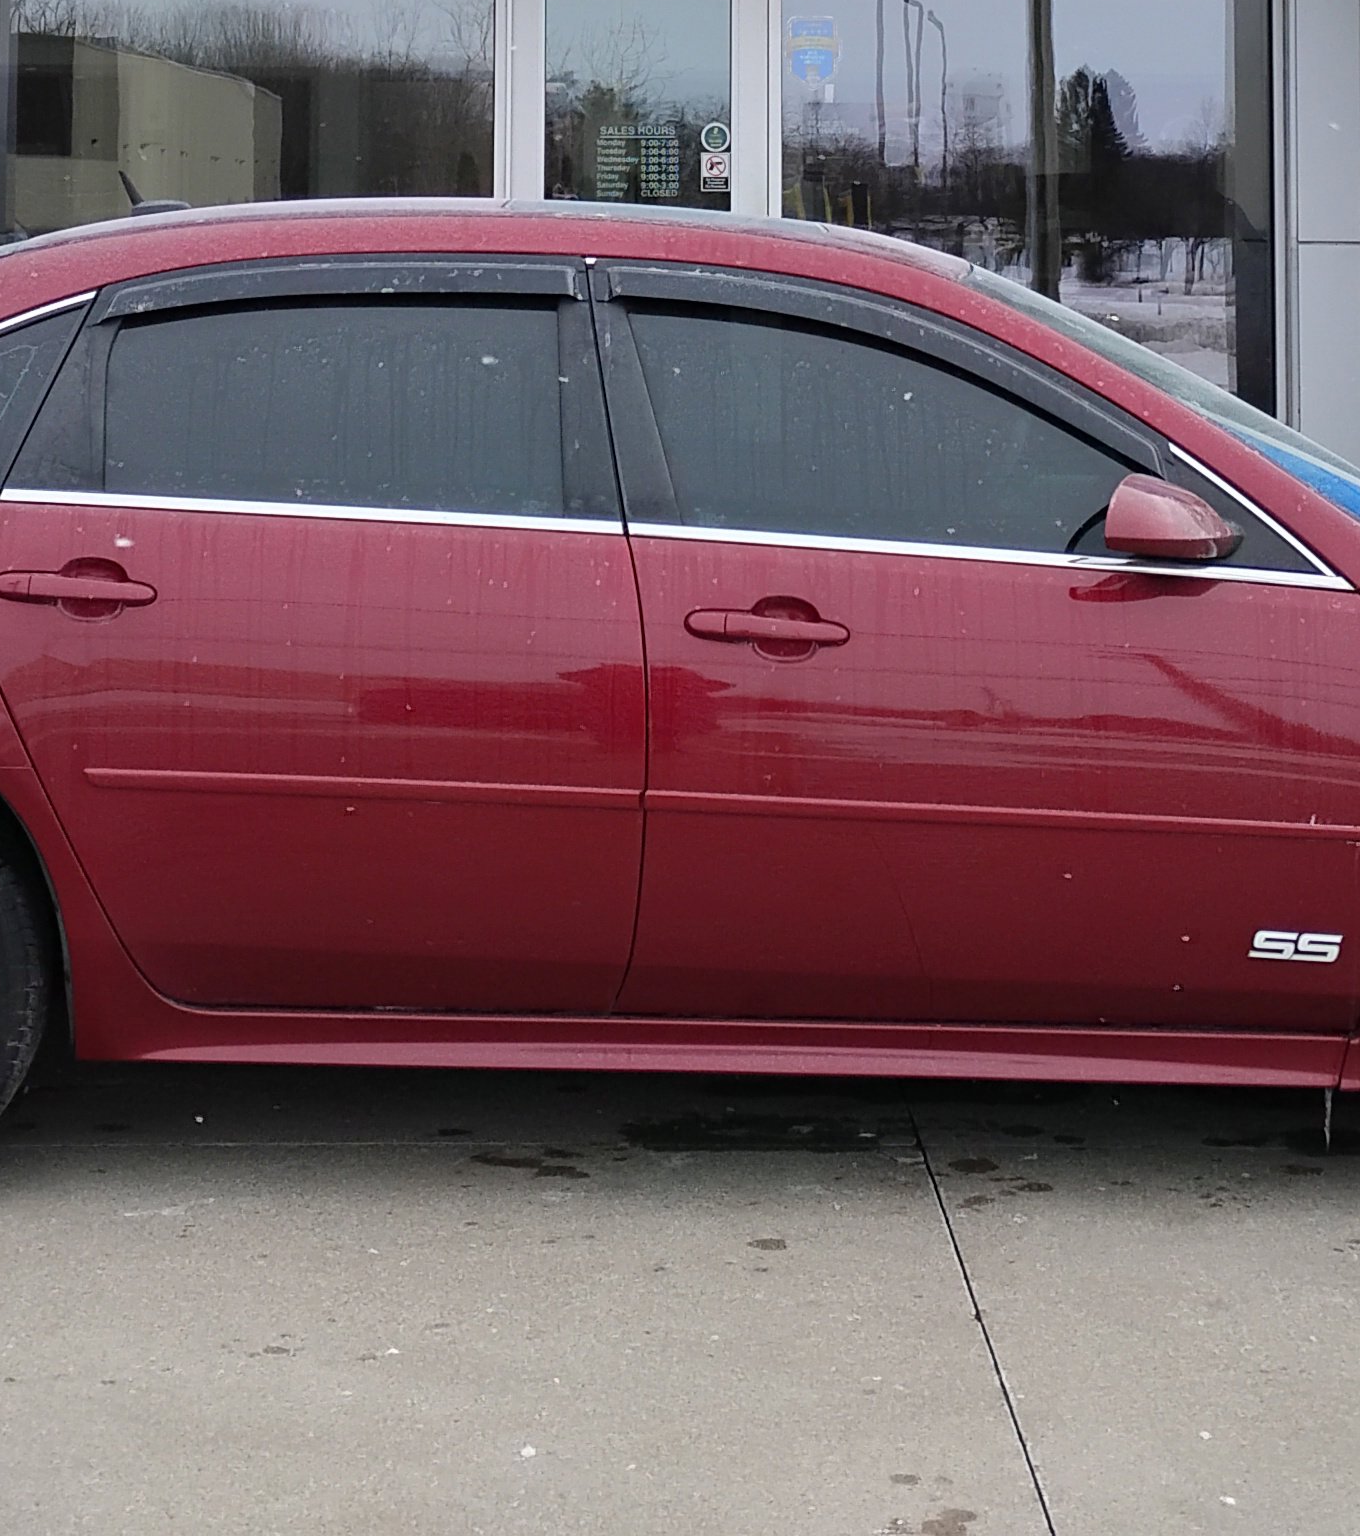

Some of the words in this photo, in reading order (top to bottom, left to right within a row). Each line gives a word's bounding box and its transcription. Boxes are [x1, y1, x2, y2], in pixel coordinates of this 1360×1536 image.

[599, 125, 635, 135] SALES
[637, 125, 676, 135] HOURS
[596, 139, 626, 147] Monday
[640, 139, 679, 147] 9:00-7:00
[596, 147, 627, 156] Tuesday
[596, 156, 639, 164] Wednesday
[596, 164, 631, 172] Thursday
[596, 173, 619, 181] Friday
[596, 181, 629, 190] Saturday
[596, 189, 624, 198] Sunday
[640, 189, 678, 197] CLOSED
[1247, 930, 1344, 963] SS
